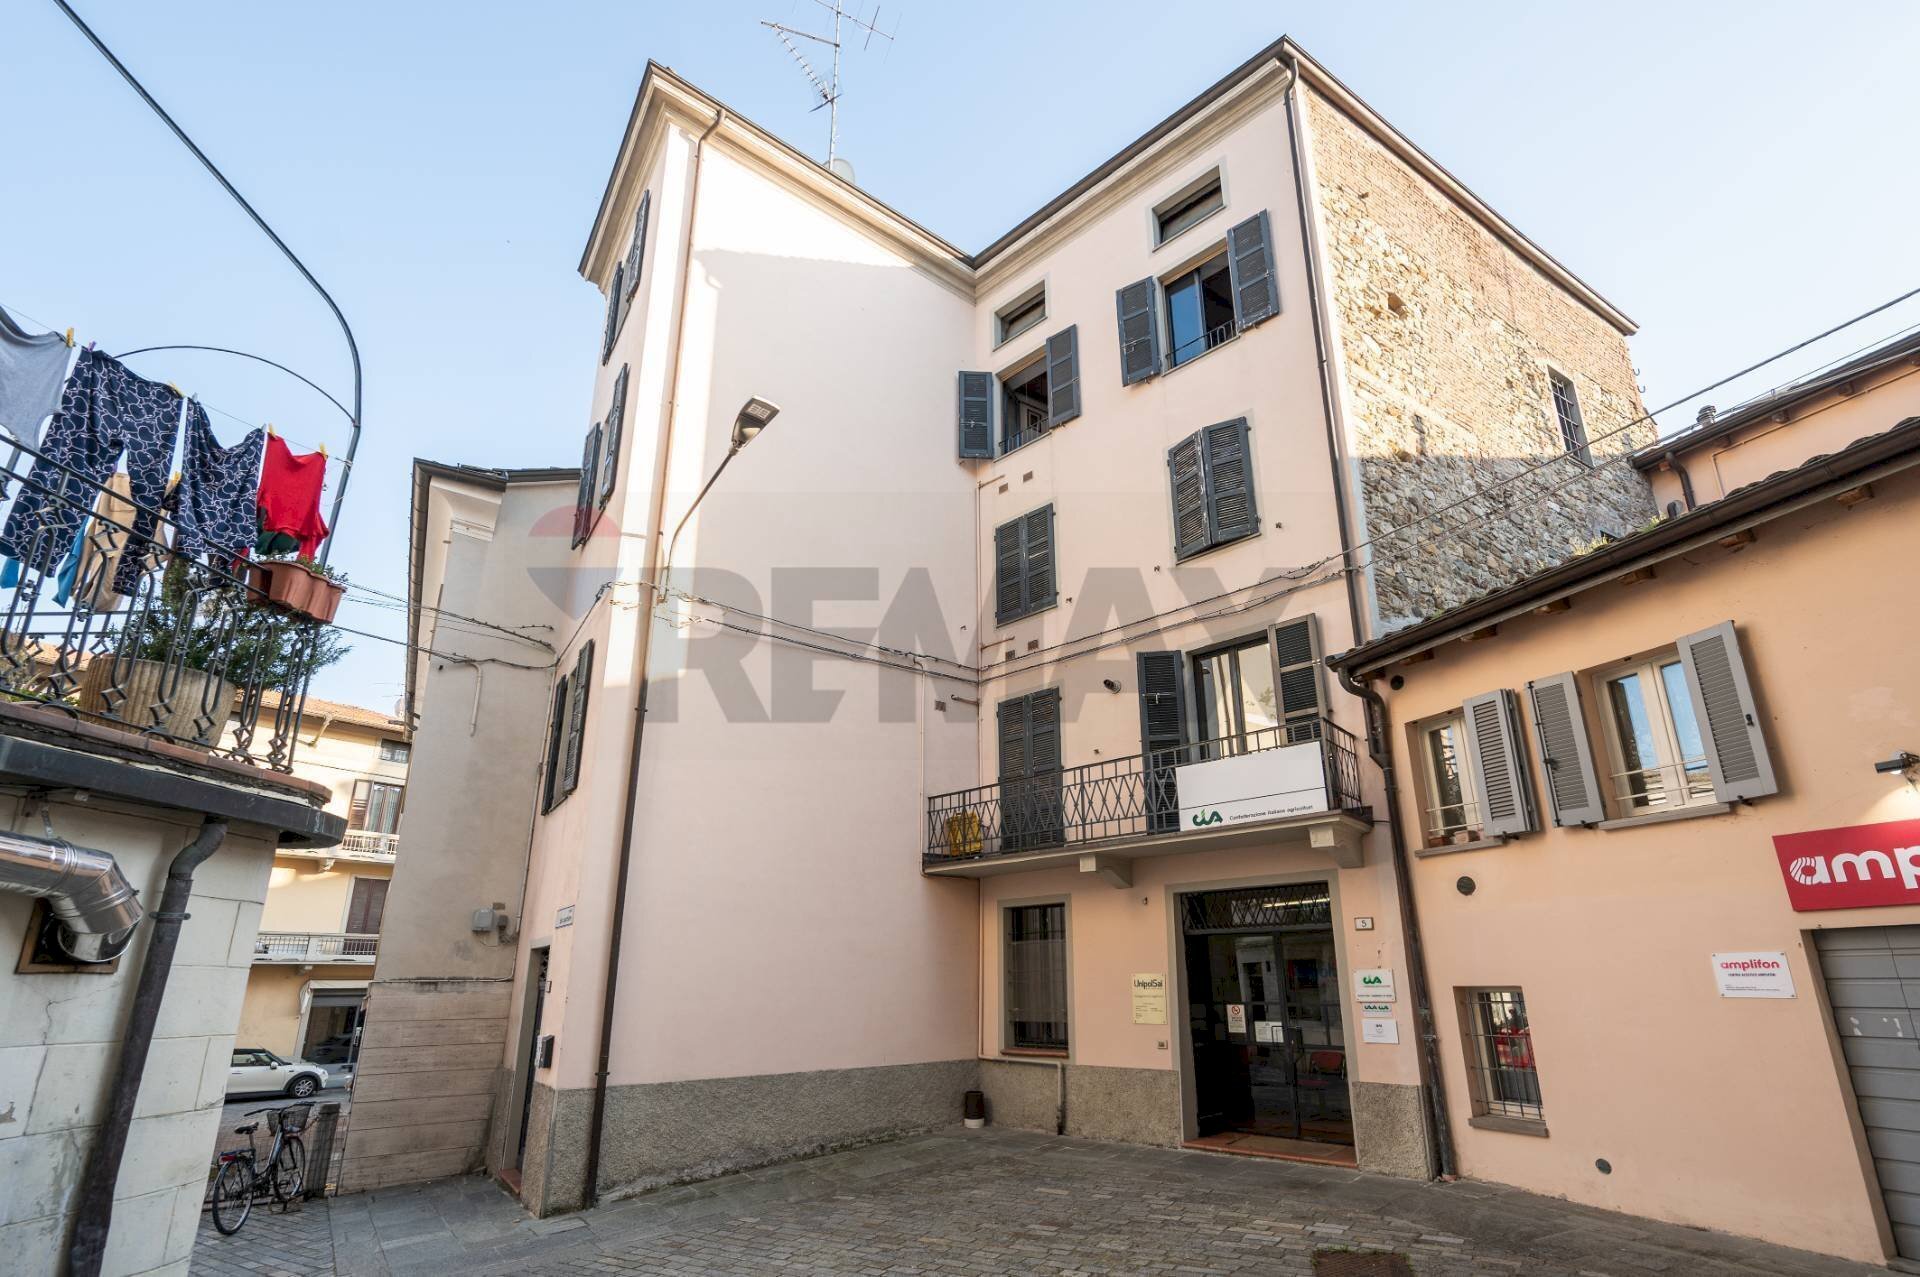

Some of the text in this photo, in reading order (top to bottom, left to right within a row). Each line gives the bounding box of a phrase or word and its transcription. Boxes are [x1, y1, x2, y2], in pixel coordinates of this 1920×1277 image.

[1361, 920, 1367, 928] 5
[1720, 958, 1780, 972] amplifon
[1134, 979, 1163, 990] UnipolSai
